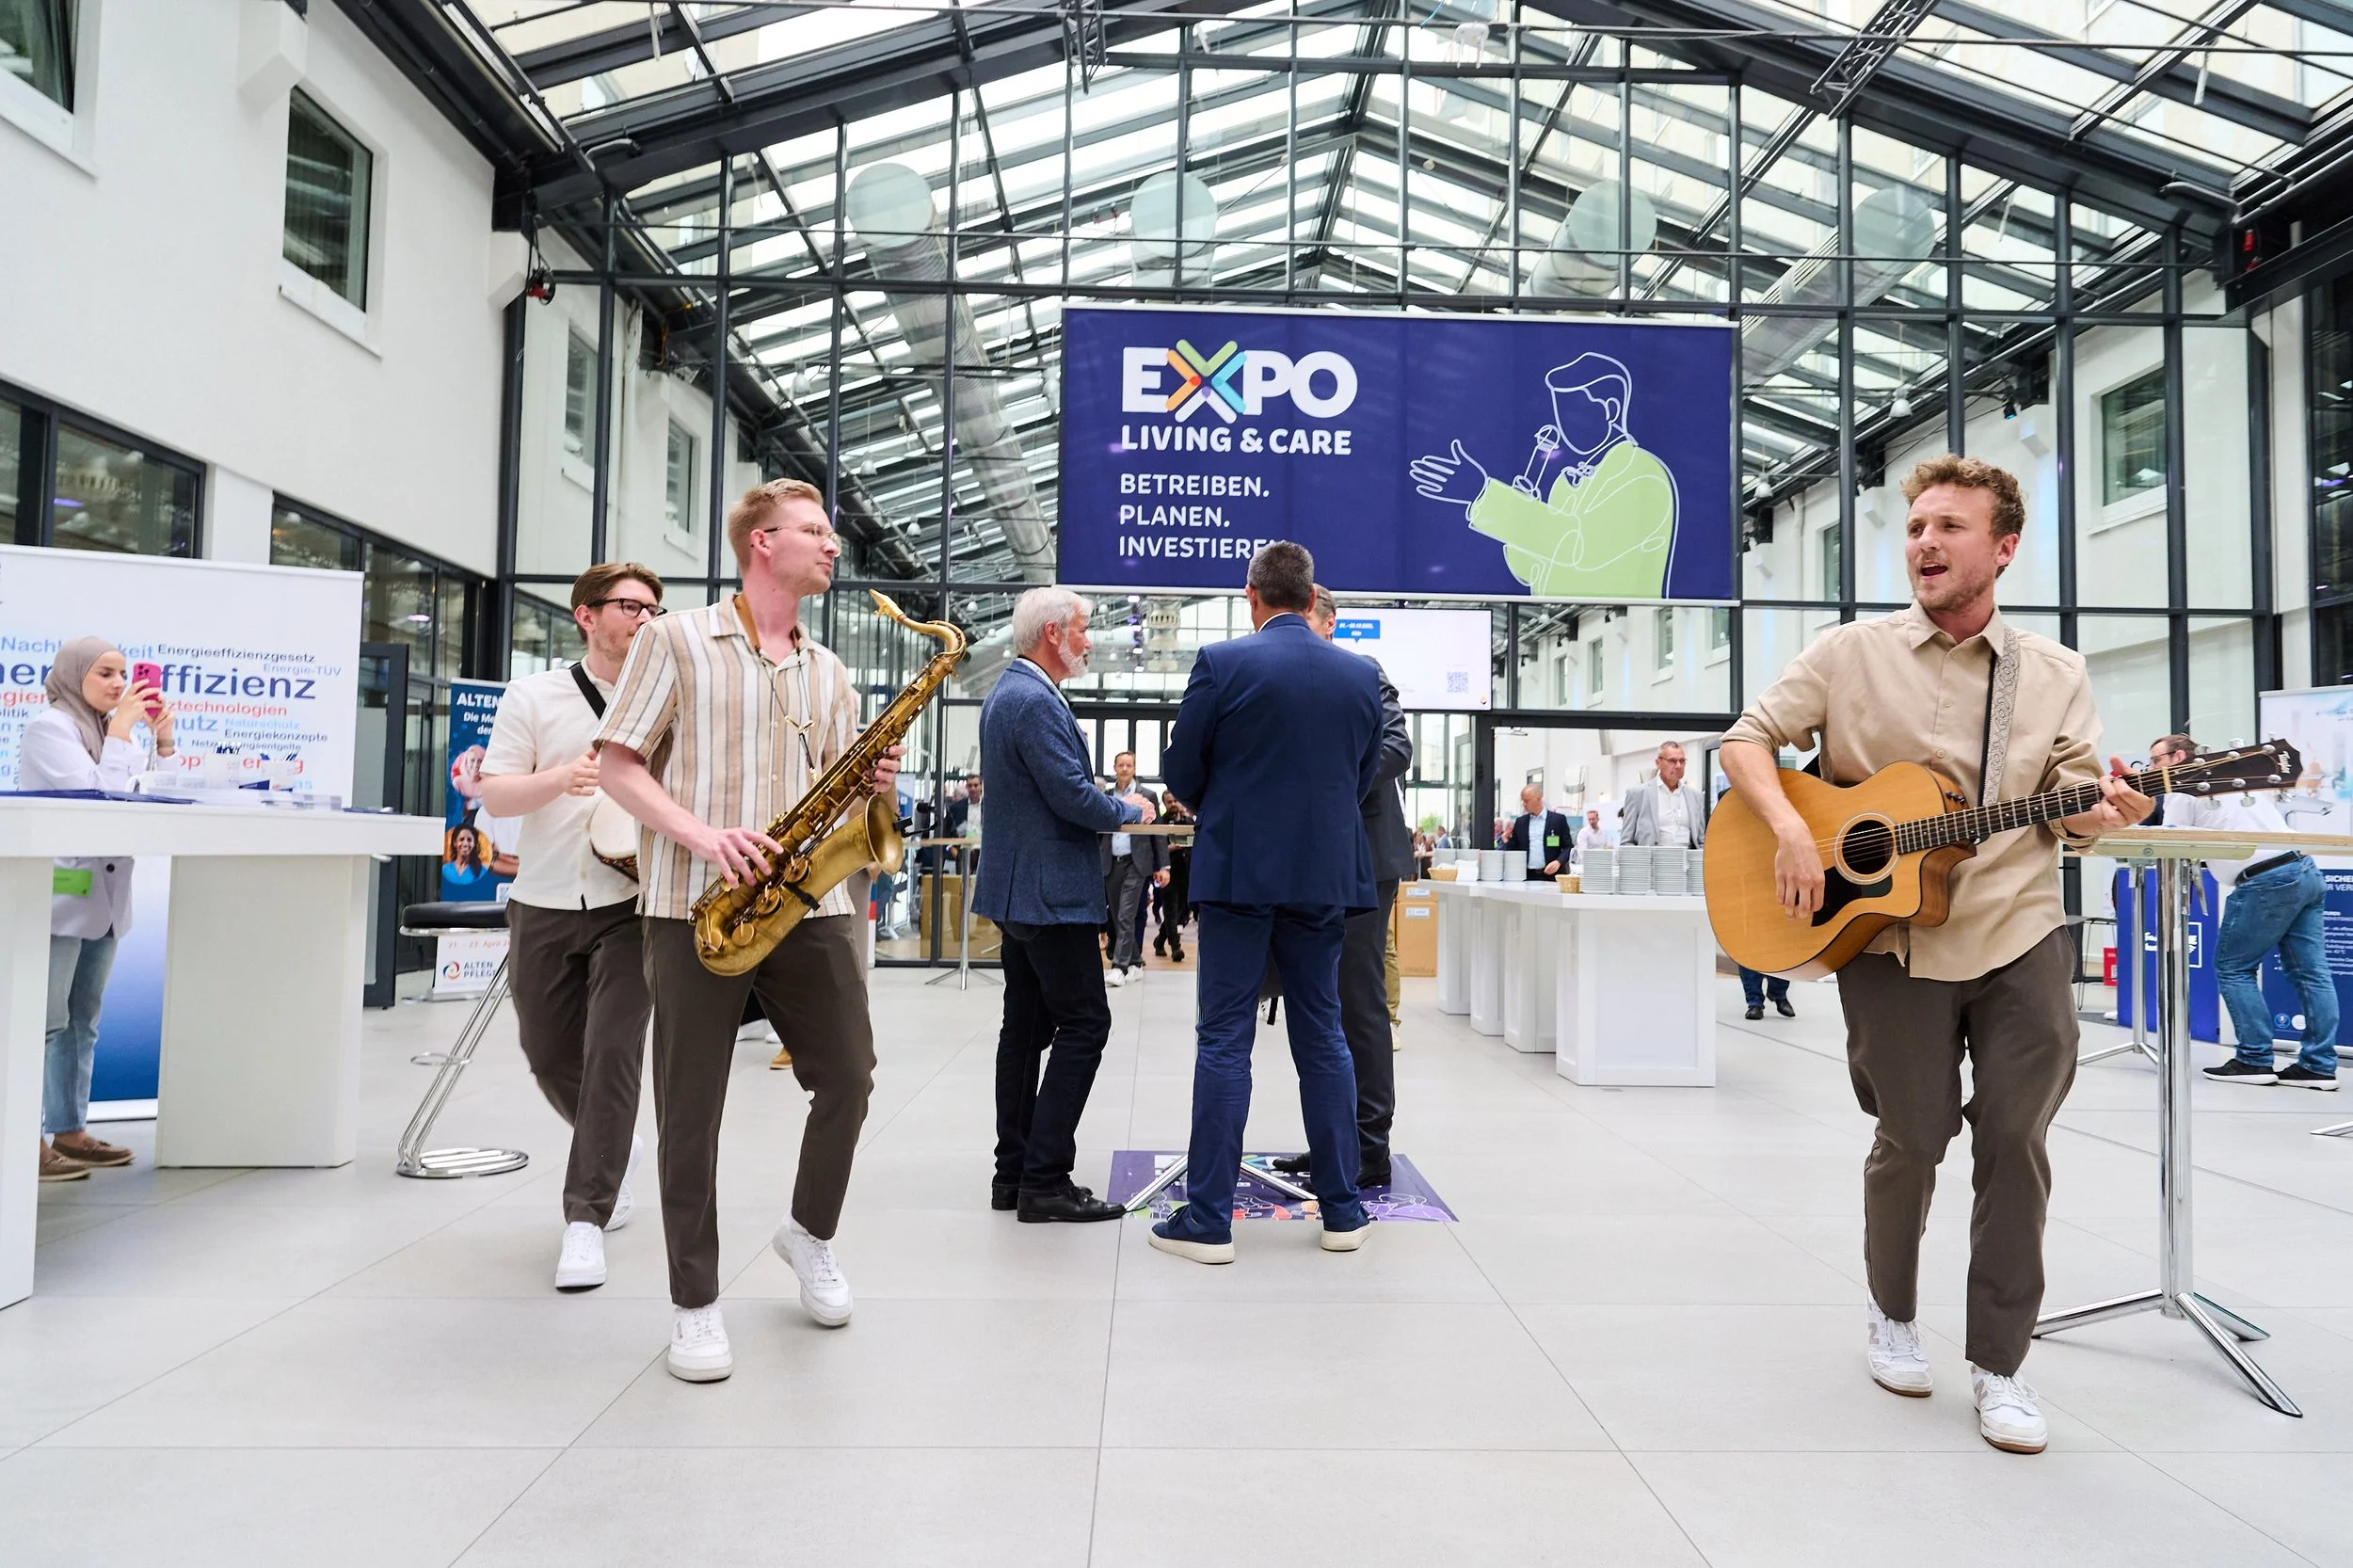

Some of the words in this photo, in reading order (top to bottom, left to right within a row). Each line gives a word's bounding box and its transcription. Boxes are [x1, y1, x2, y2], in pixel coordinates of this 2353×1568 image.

[1122, 339, 1358, 424] EXPO
[1121, 424, 1232, 452] LIVING
[1240, 427, 1264, 453] &
[1269, 428, 1352, 456] CARE
[1120, 473, 1270, 498] BETREIBEN.
[1119, 504, 1230, 527] PLANEN.
[1119, 536, 1286, 559] INVESTIERE
[158, 644, 316, 664] Energieeffizienzgesetz
[225, 718, 300, 729] Naturschutz
[463, 712, 480, 723] Die
[224, 728, 328, 743] Energiekonzepte
